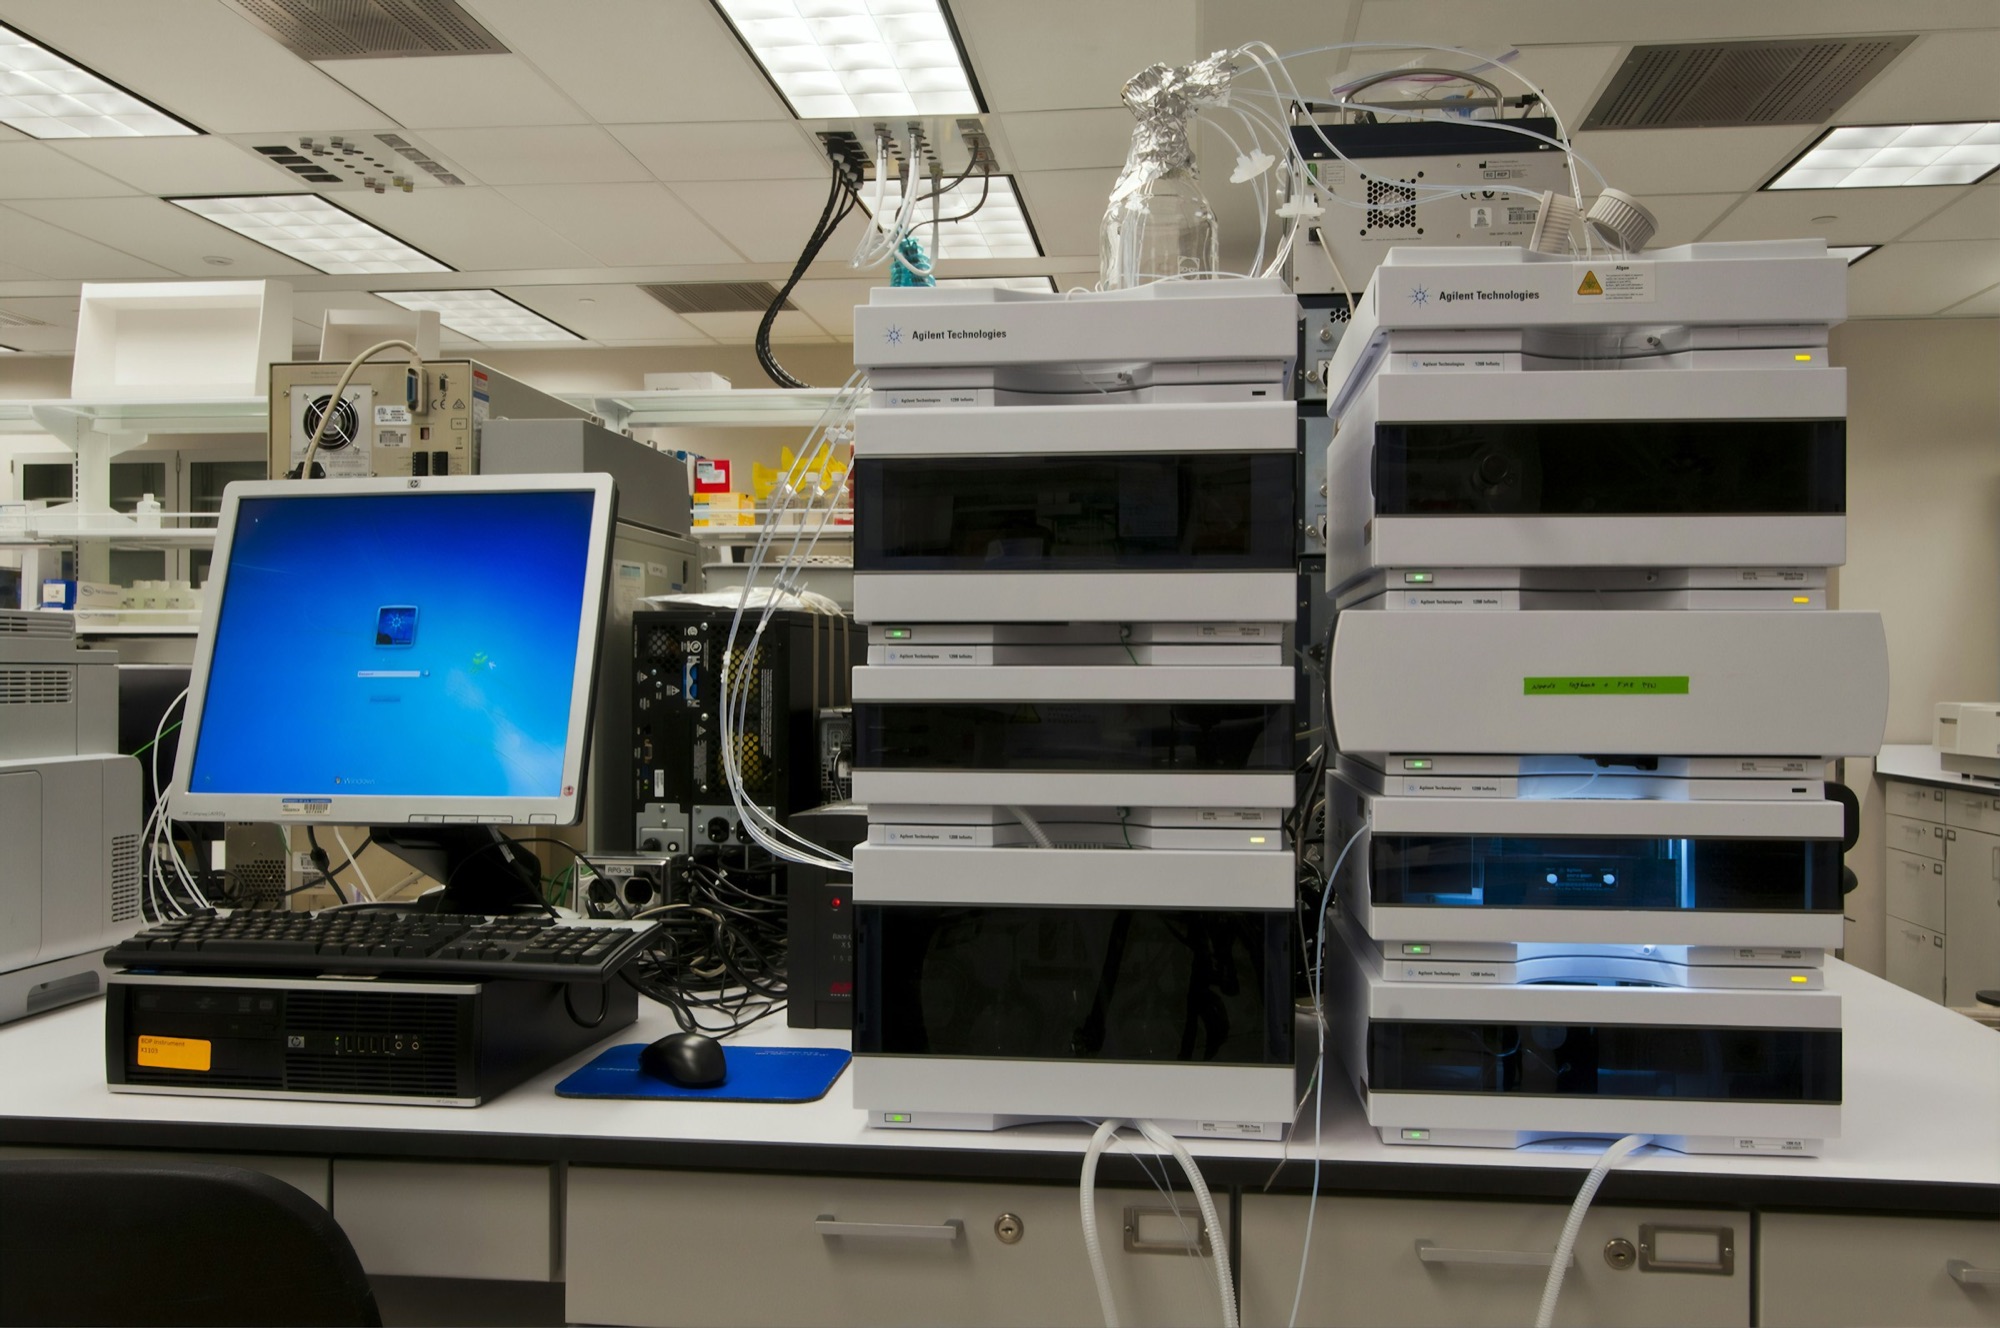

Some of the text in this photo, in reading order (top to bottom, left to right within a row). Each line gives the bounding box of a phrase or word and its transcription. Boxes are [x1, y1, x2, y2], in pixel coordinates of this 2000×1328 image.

[1439, 290, 1540, 302] Agilent Technologies
[912, 329, 1007, 341] Agilent Technologies
